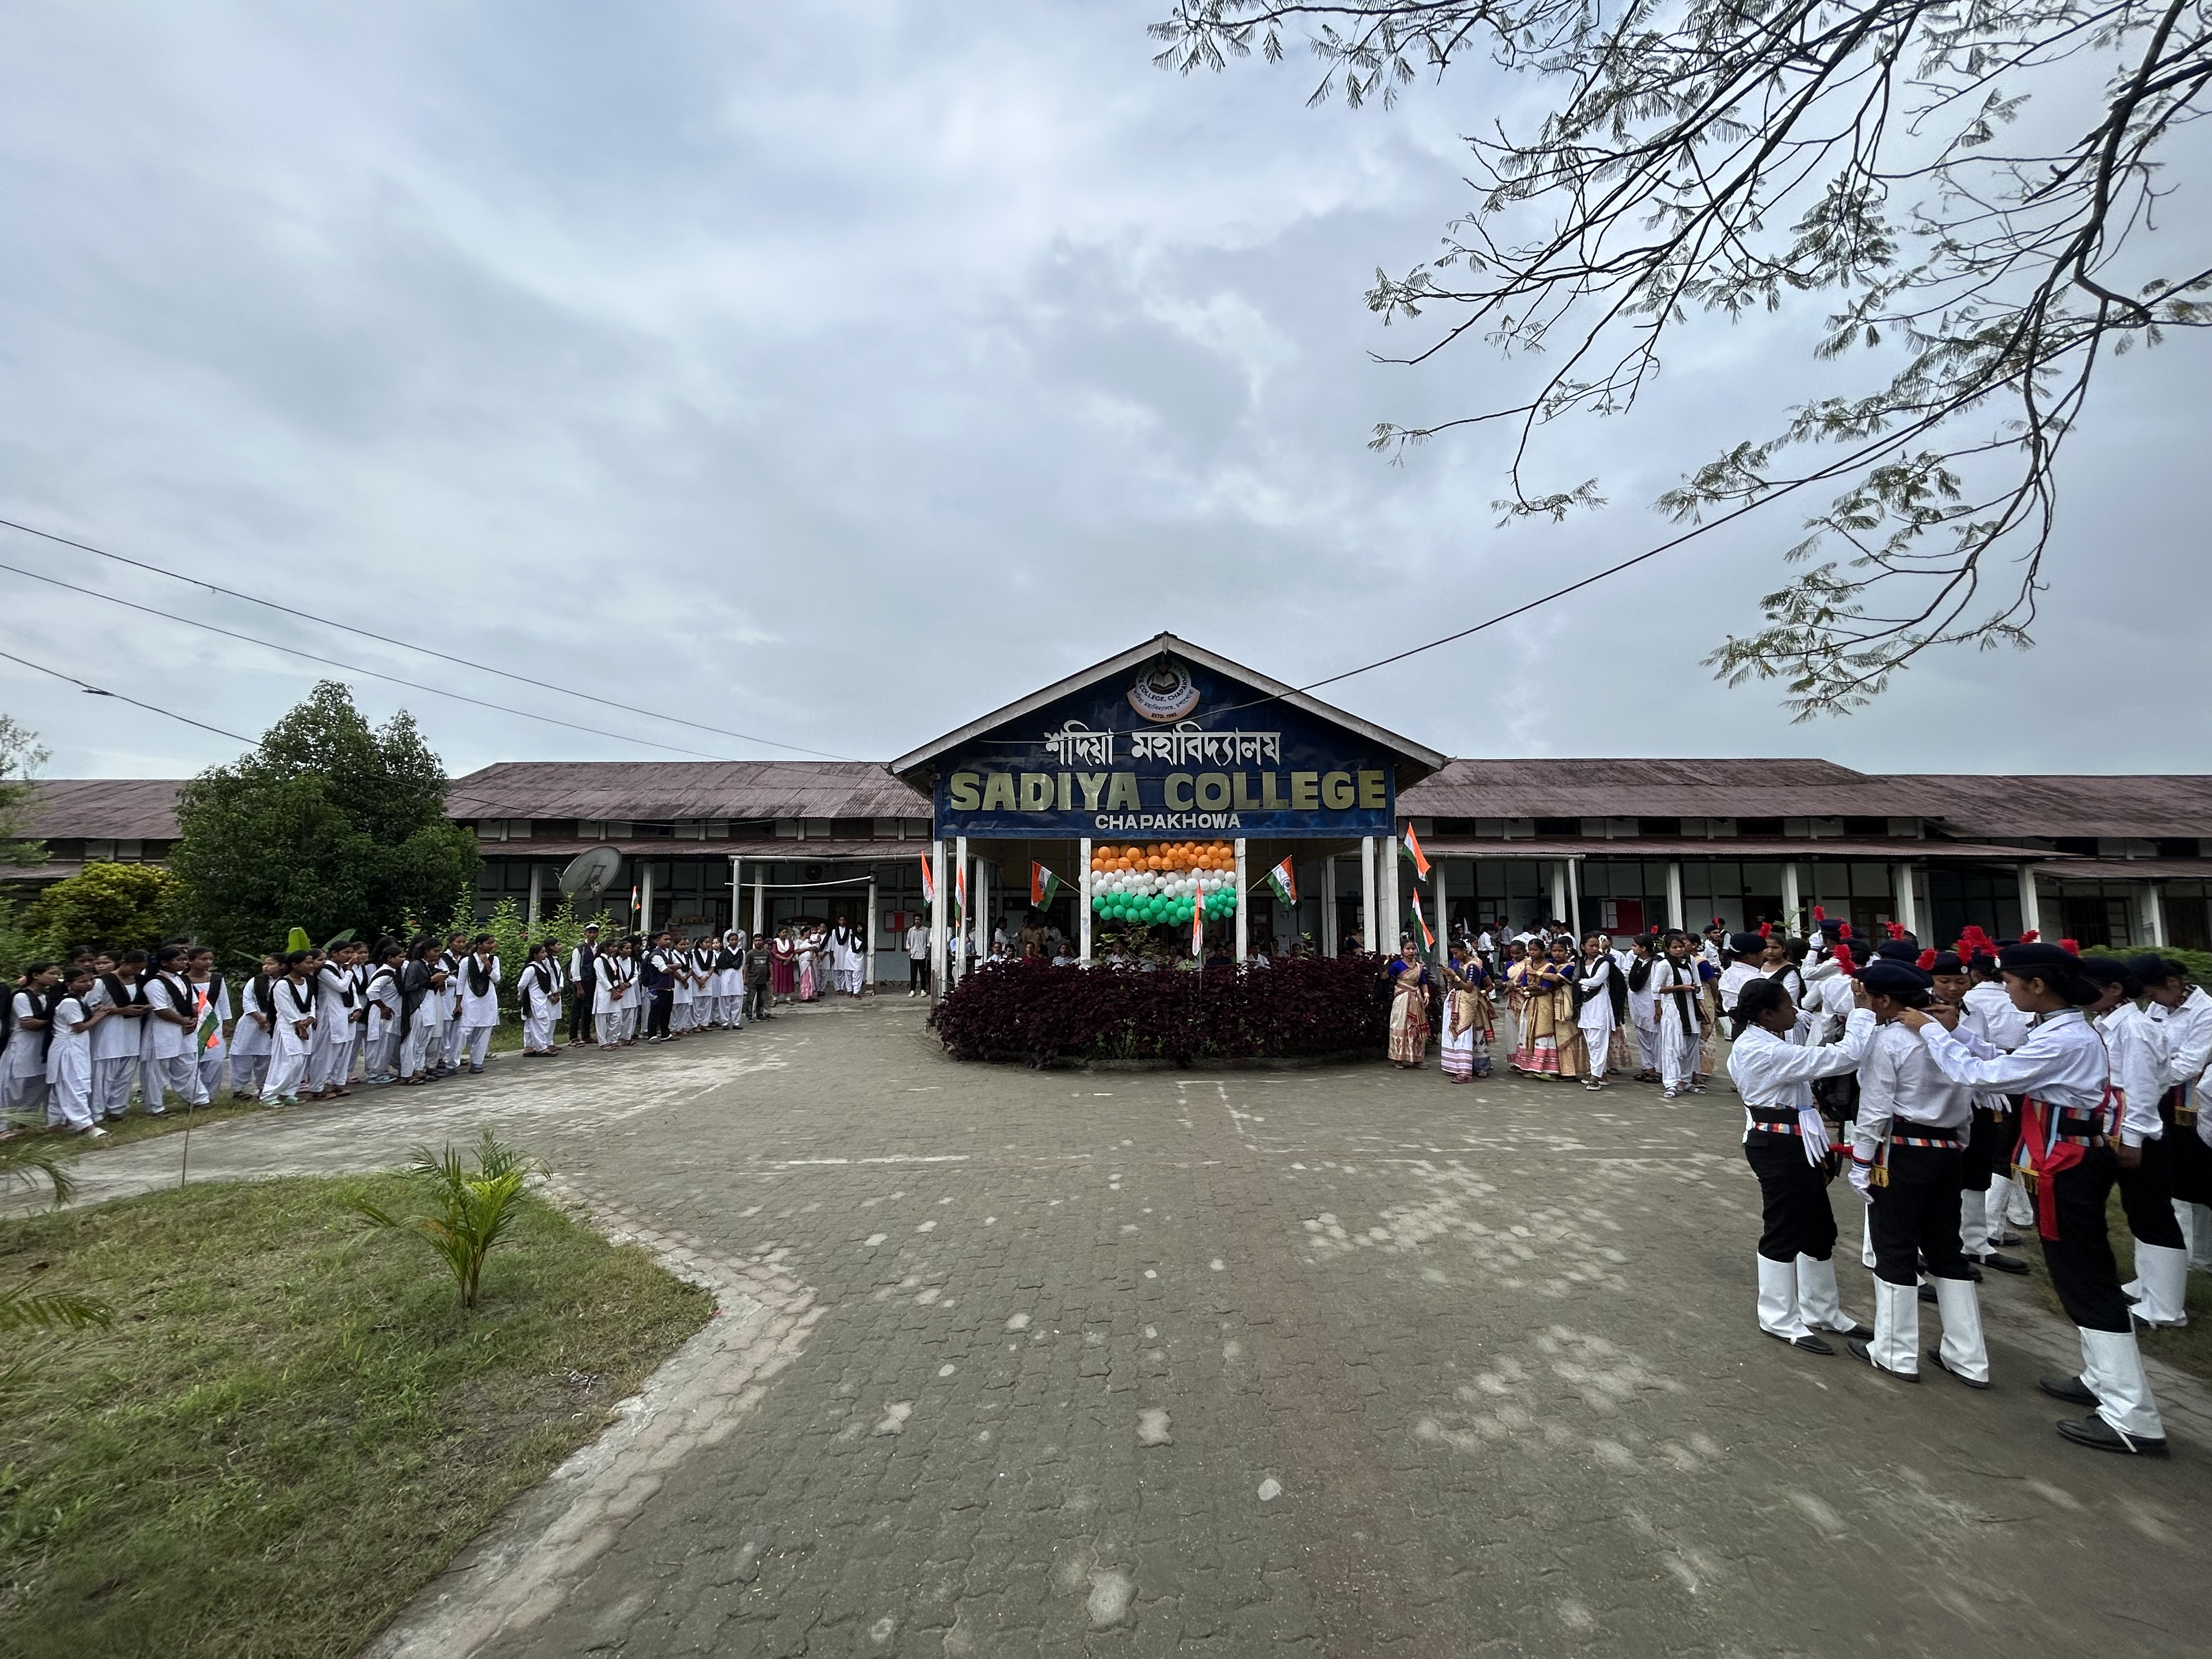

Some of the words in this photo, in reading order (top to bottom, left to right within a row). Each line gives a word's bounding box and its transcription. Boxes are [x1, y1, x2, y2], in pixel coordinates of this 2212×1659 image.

[1139, 685, 1166, 702] COLLEGE,
[1168, 664, 1188, 701] CHAPAKHOWA
[951, 772, 1141, 811] SADIYA
[1164, 770, 1386, 810] COLLEGE
[1095, 814, 1241, 830] CHAPAKHOWA
